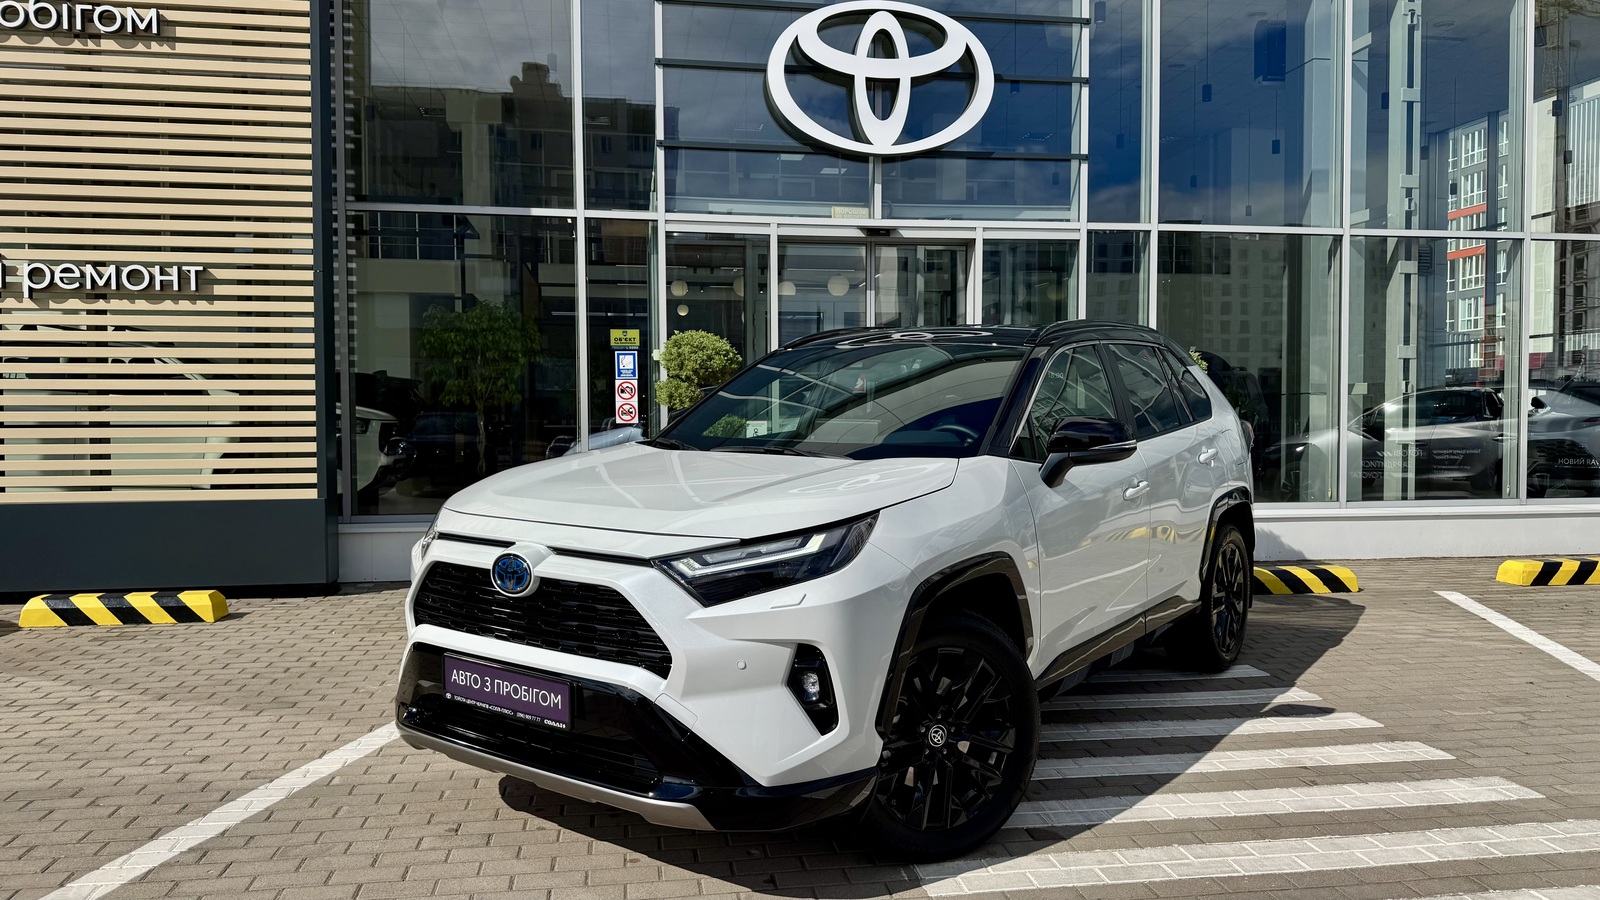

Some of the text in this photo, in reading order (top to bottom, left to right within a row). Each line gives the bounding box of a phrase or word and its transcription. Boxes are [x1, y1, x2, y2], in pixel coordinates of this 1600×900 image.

[0, 0, 160, 35] обігом
[23, 262, 204, 298] ремонт
[451, 669, 481, 689] АВТО
[494, 679, 562, 710] ПРОБІГОМ
